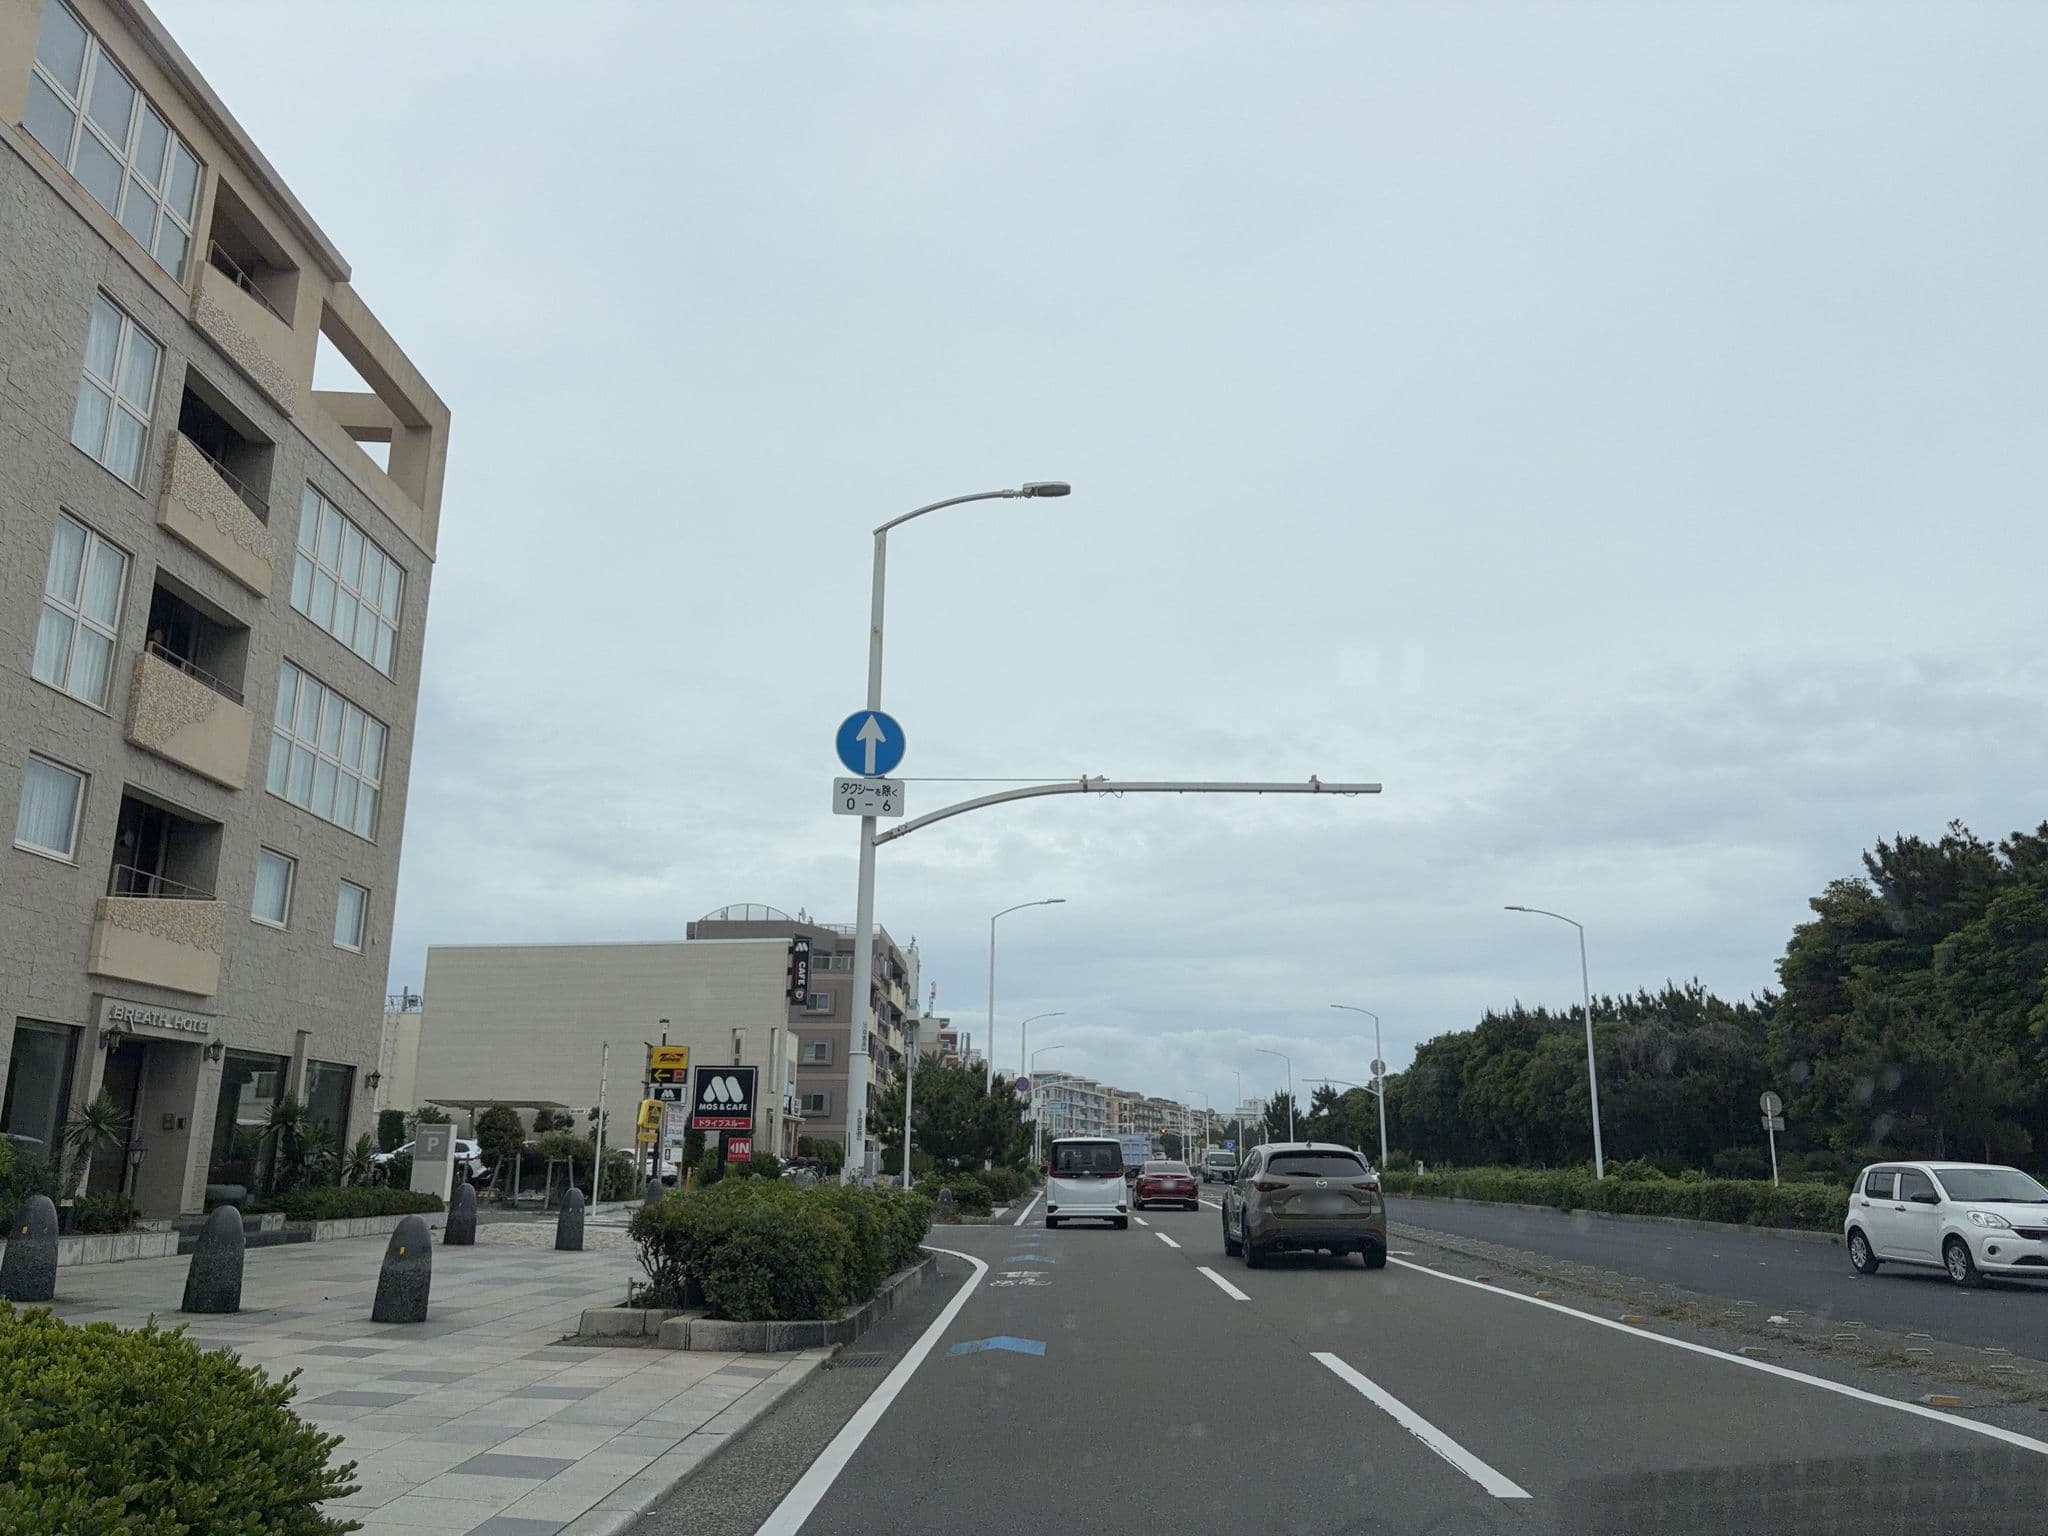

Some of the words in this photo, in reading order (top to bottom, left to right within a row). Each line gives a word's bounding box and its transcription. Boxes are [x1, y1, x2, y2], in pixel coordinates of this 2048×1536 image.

[841, 783, 898, 797] タクシーを除く
[847, 798, 855, 810] 0
[883, 800, 891, 811] 6
[113, 1006, 172, 1031] BREATH
[698, 1103, 718, 1111] MOS
[726, 1103, 748, 1111] CAFE
[427, 1137, 440, 1152] P
[735, 1142, 749, 1153] IN
